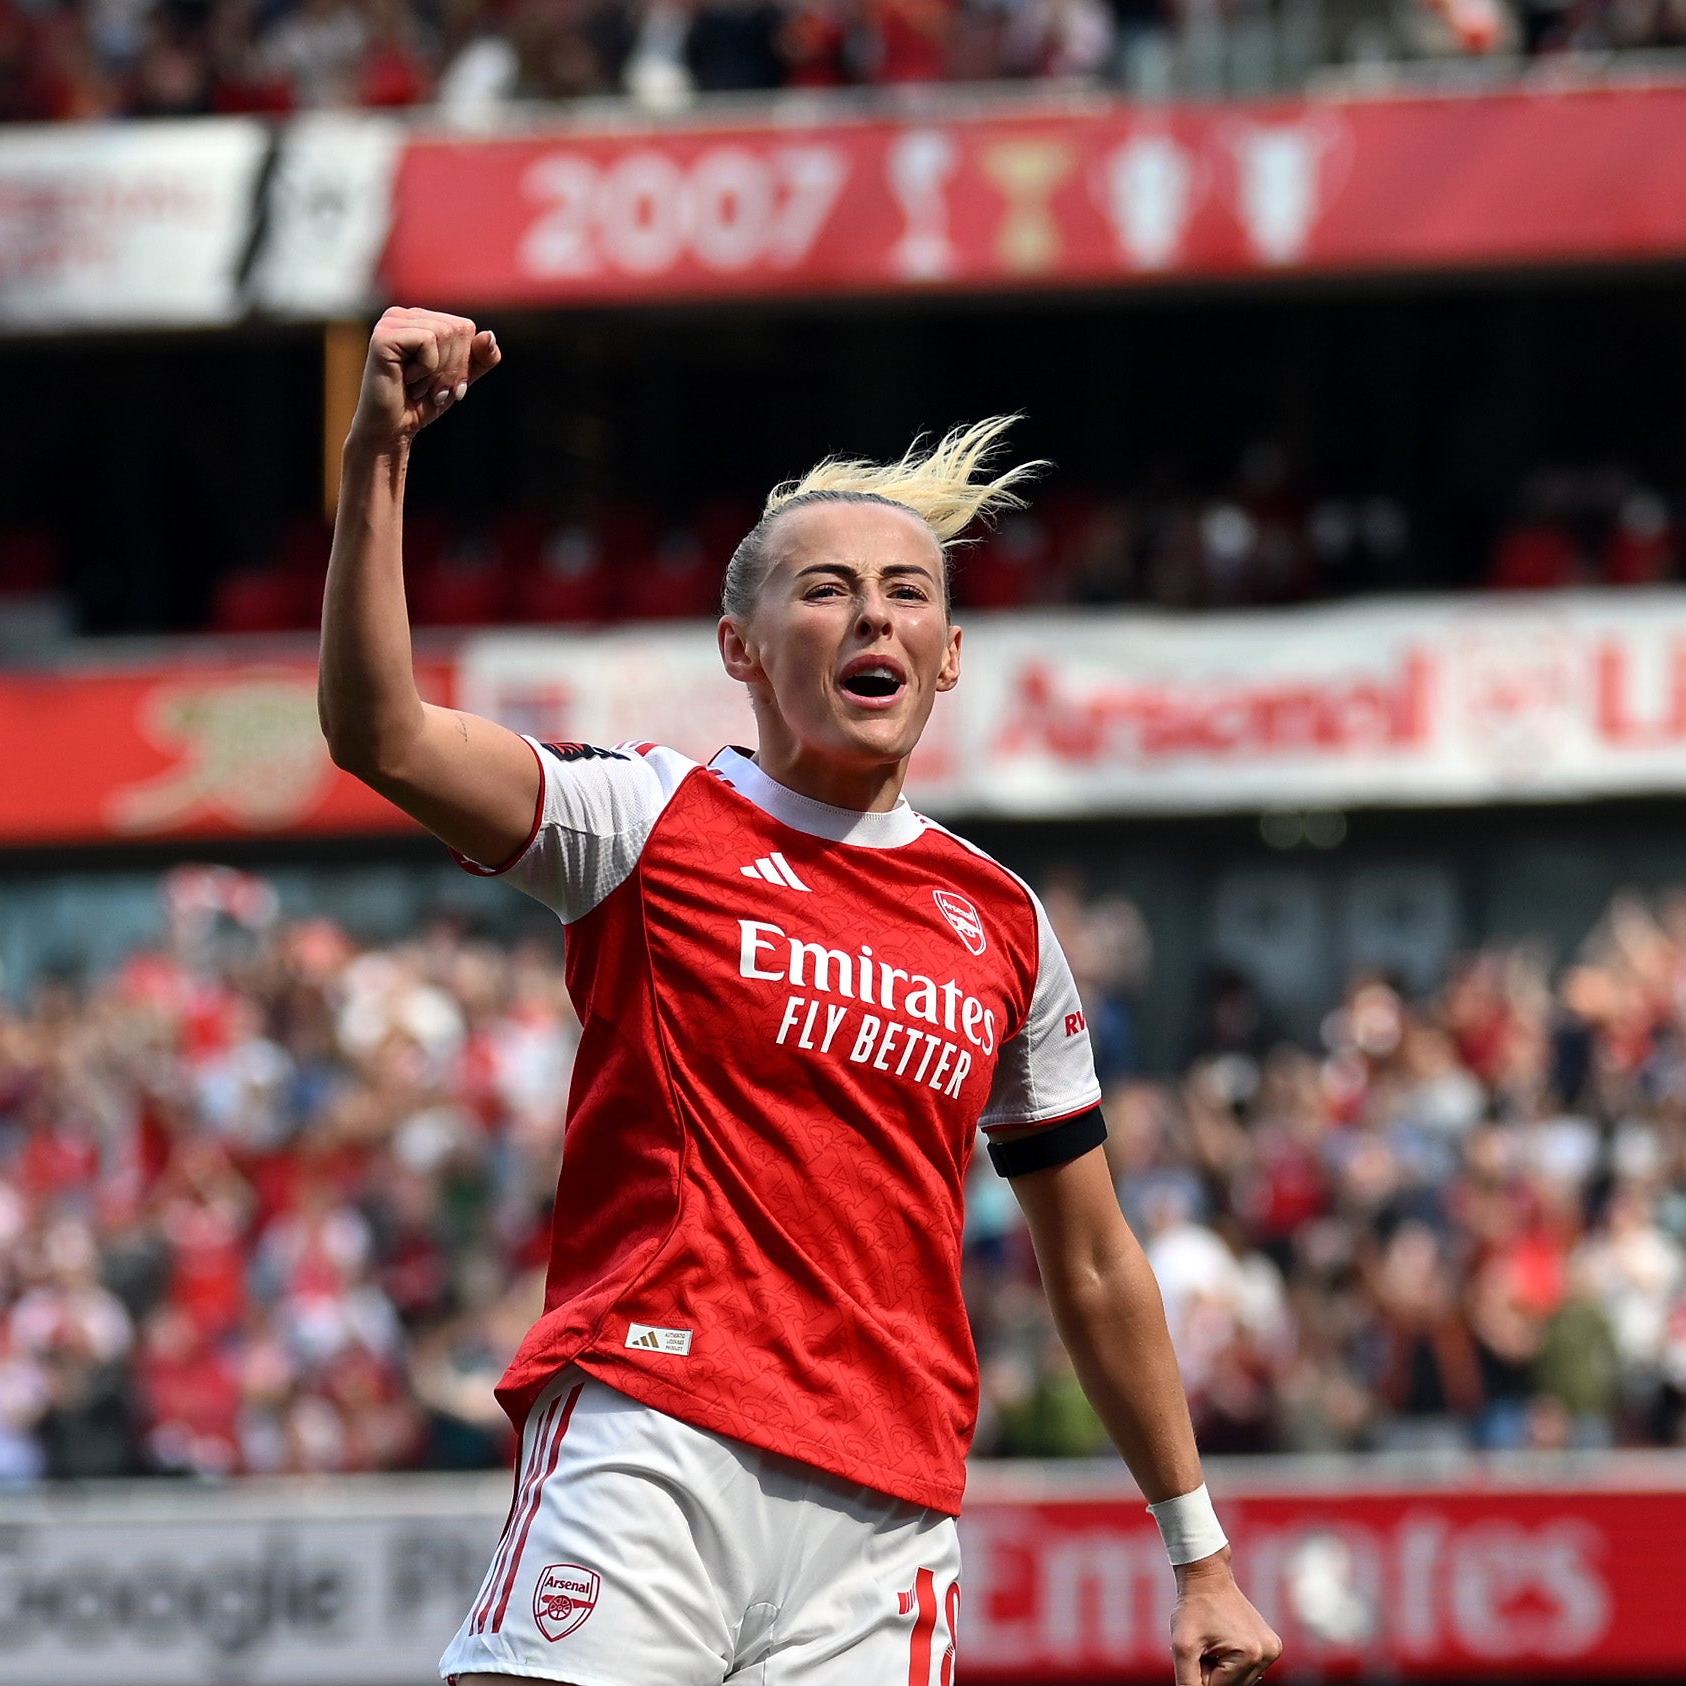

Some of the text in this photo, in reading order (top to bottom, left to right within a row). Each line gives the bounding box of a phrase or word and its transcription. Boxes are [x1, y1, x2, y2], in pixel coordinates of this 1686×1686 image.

[518, 142, 846, 280] 2007
[994, 643, 1432, 762] Arsenal
[737, 919, 996, 1056] Emirates
[776, 995, 974, 1100] FLY BETTER
[544, 1575, 590, 1594] Arsenal
